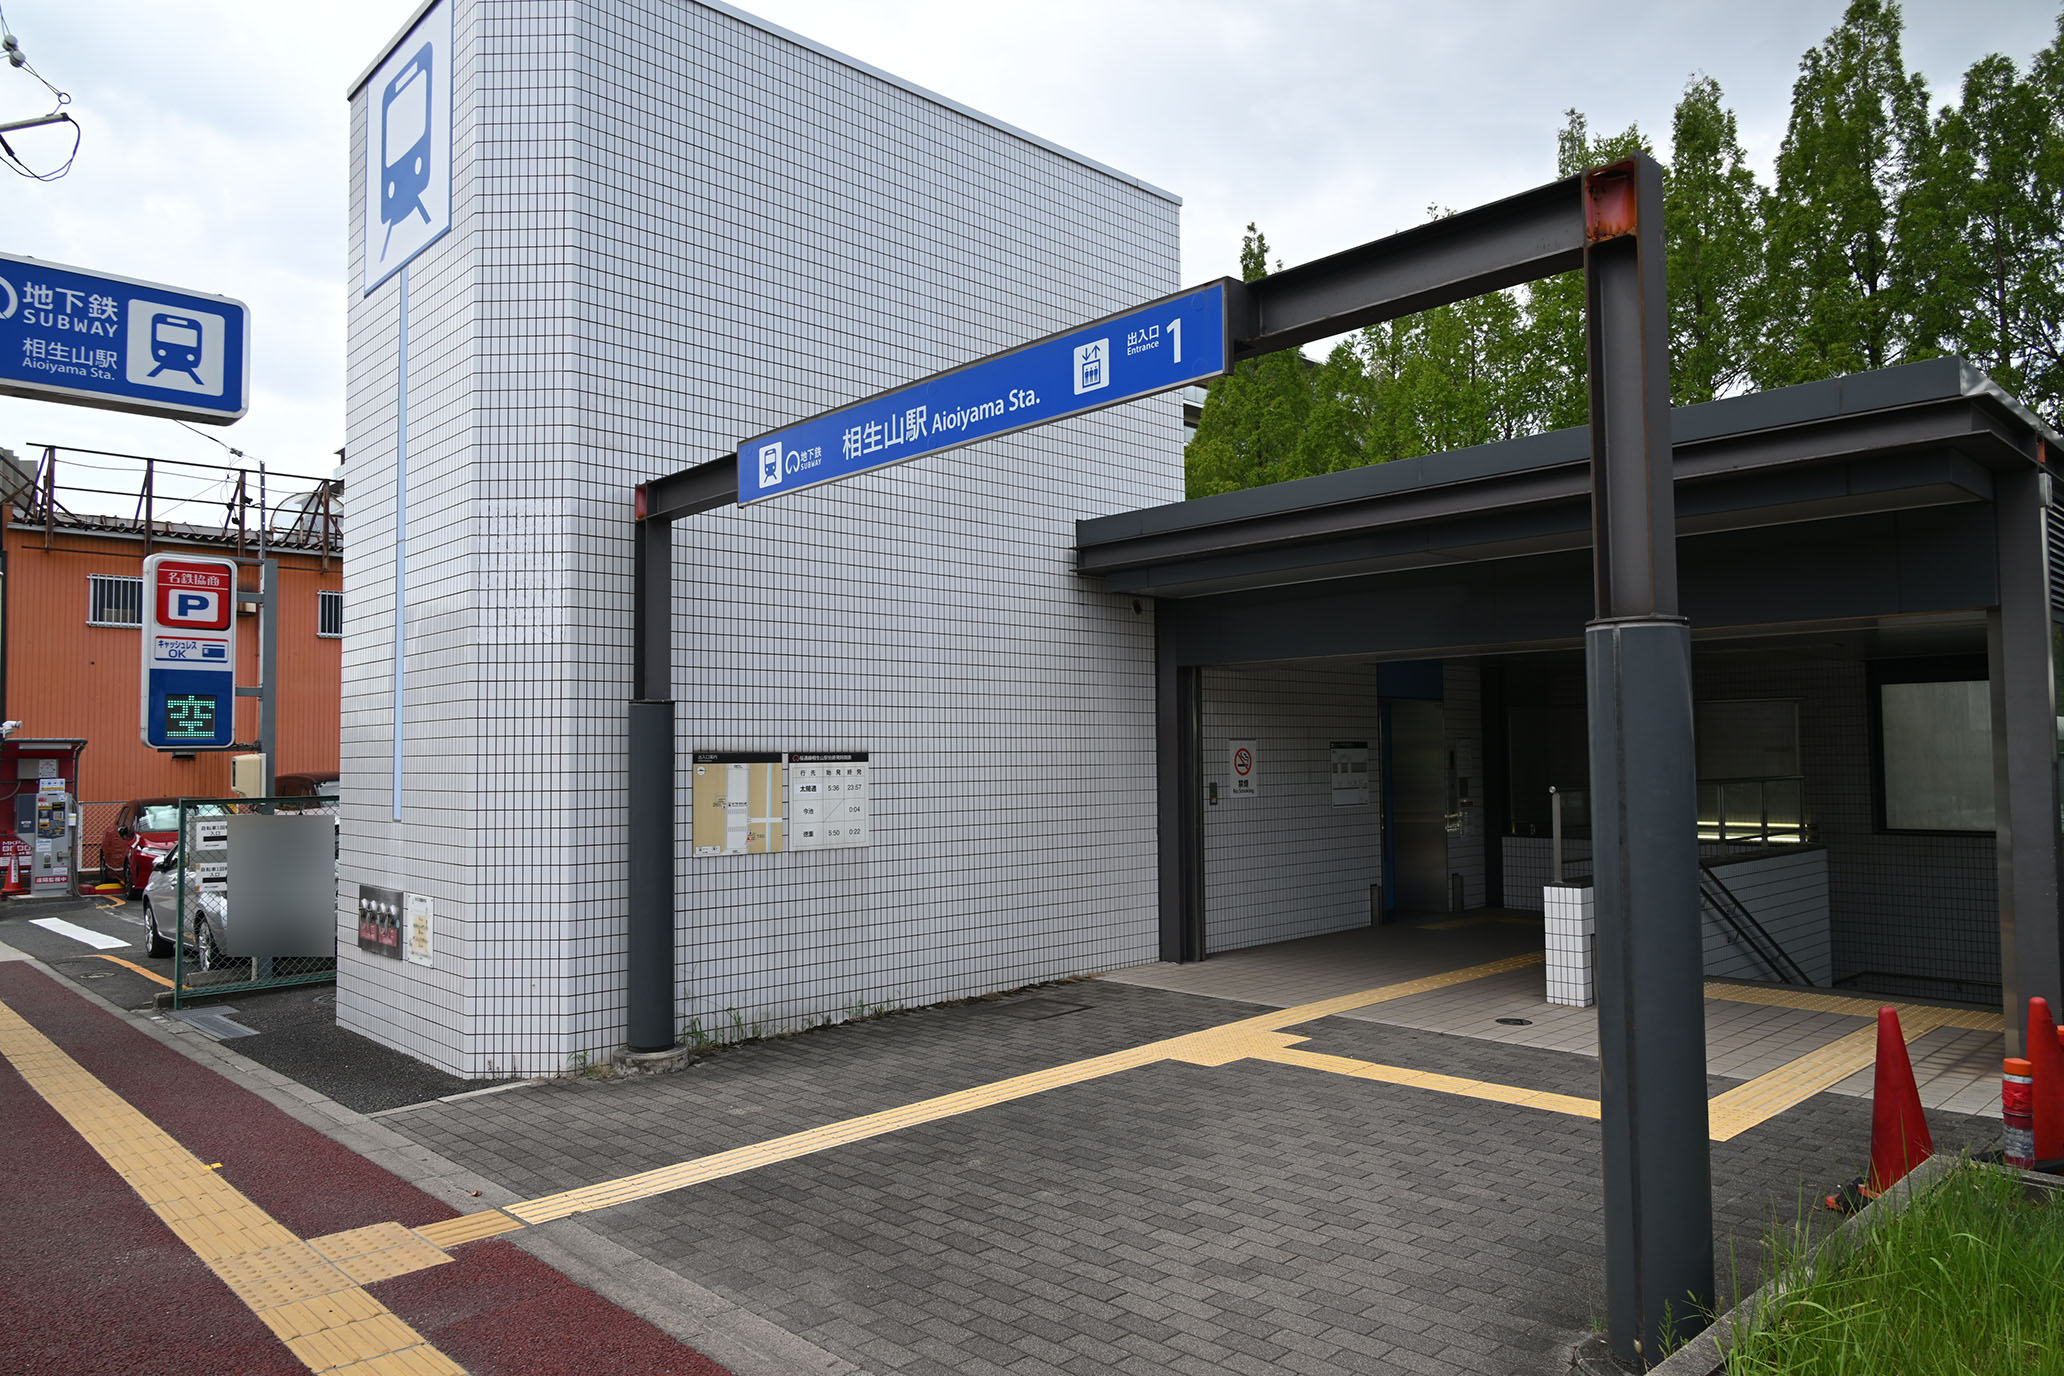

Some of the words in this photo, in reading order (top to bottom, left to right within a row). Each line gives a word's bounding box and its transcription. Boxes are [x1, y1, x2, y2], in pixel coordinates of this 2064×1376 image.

[22, 281, 118, 322] 地下鉄
[23, 309, 118, 338] SUBWAY
[1127, 324, 1160, 347] 出入口
[1166, 317, 1182, 364] 1
[22, 337, 118, 370] 相生山駅
[1127, 340, 1160, 356] Entrance
[22, 357, 87, 376] Aioiyama
[90, 367, 116, 381] Sta.
[842, 404, 928, 461] 相生山駅
[931, 398, 1005, 434] Aioiyama
[1008, 388, 1041, 412] Sta.
[800, 446, 822, 462] 地下鉄
[800, 458, 822, 471] SUBWAY
[167, 572, 220, 587] 名鉄協商
[177, 594, 210, 617] P
[157, 639, 198, 650] キャッシュレス
[168, 649, 187, 659] OK
[167, 695, 216, 737] 空
